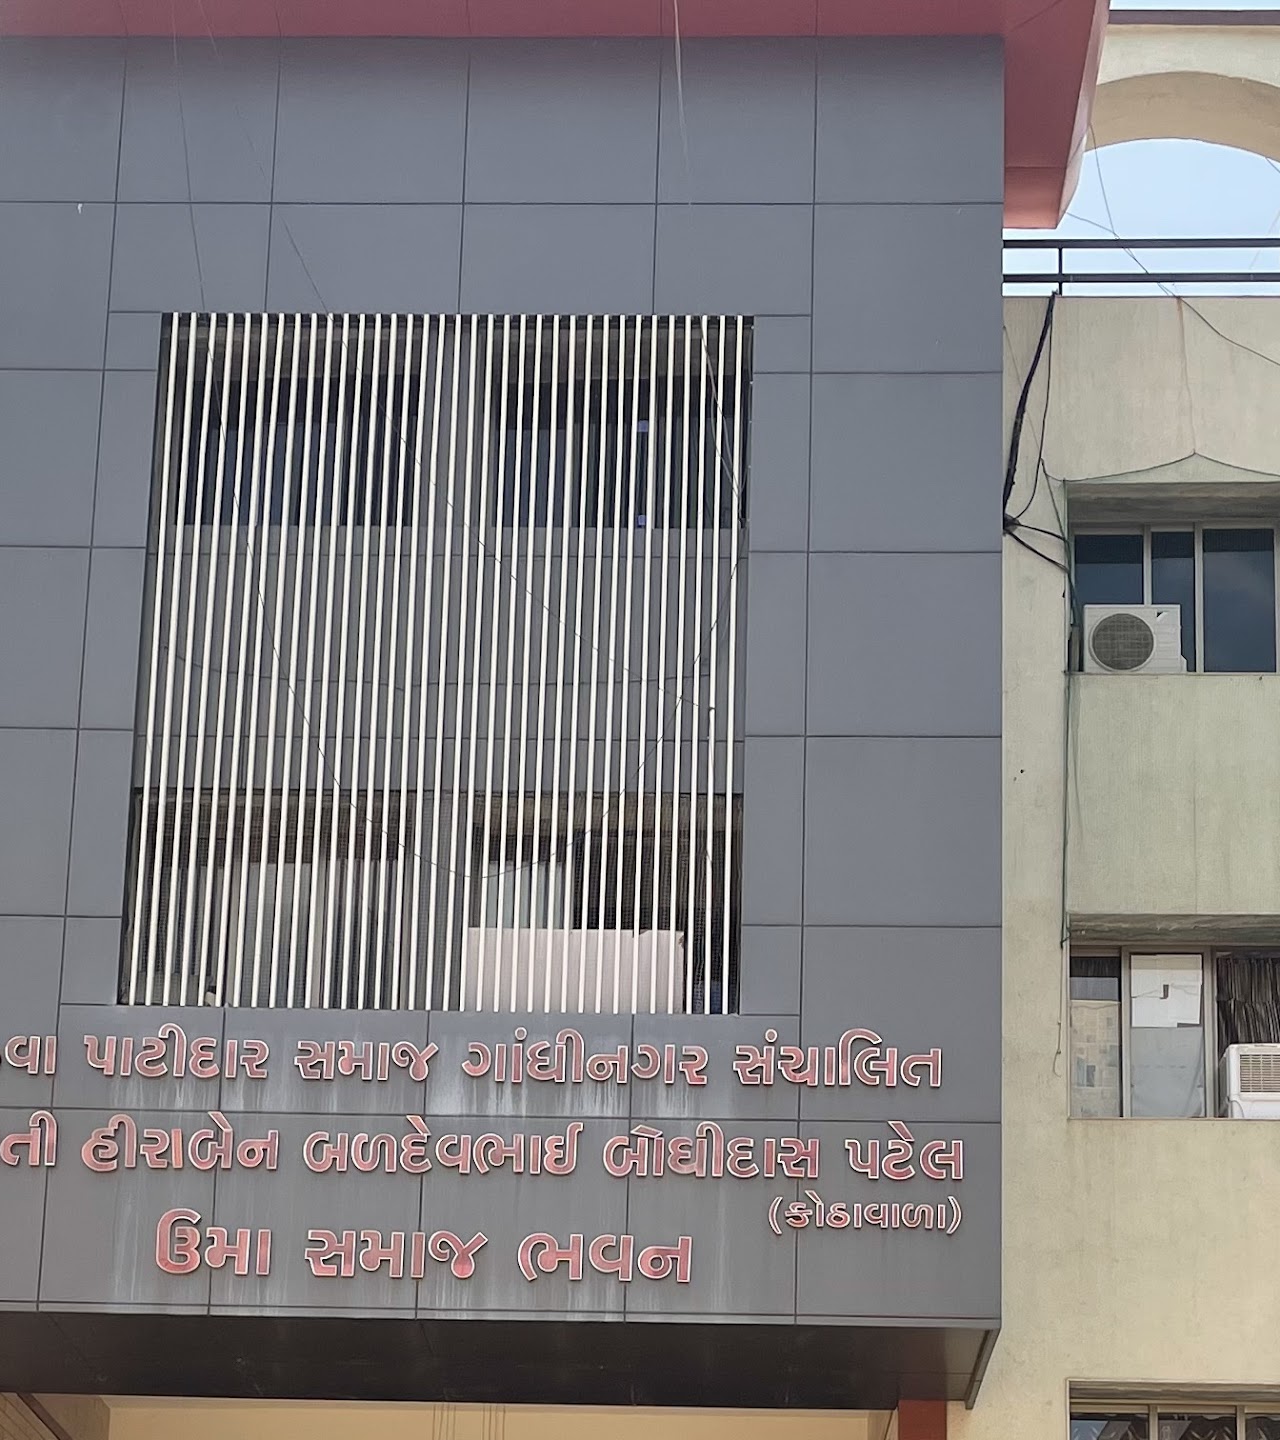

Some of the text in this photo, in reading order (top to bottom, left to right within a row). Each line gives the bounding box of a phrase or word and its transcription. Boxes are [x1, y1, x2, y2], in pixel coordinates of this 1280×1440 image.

[84, 1023, 270, 1080] પાટીદાર
[294, 1038, 439, 1082] સમાજ
[732, 1028, 943, 1088] સંચાલિત
[81, 1111, 280, 1173] હીરાબેન
[302, 1115, 584, 1176] બળદેવભાઈ
[845, 1120, 965, 1181] પટેલ
[155, 1208, 693, 1284] ઉમા સમાજ ભવન
[768, 1190, 963, 1236] (કોઠાવાળા)
